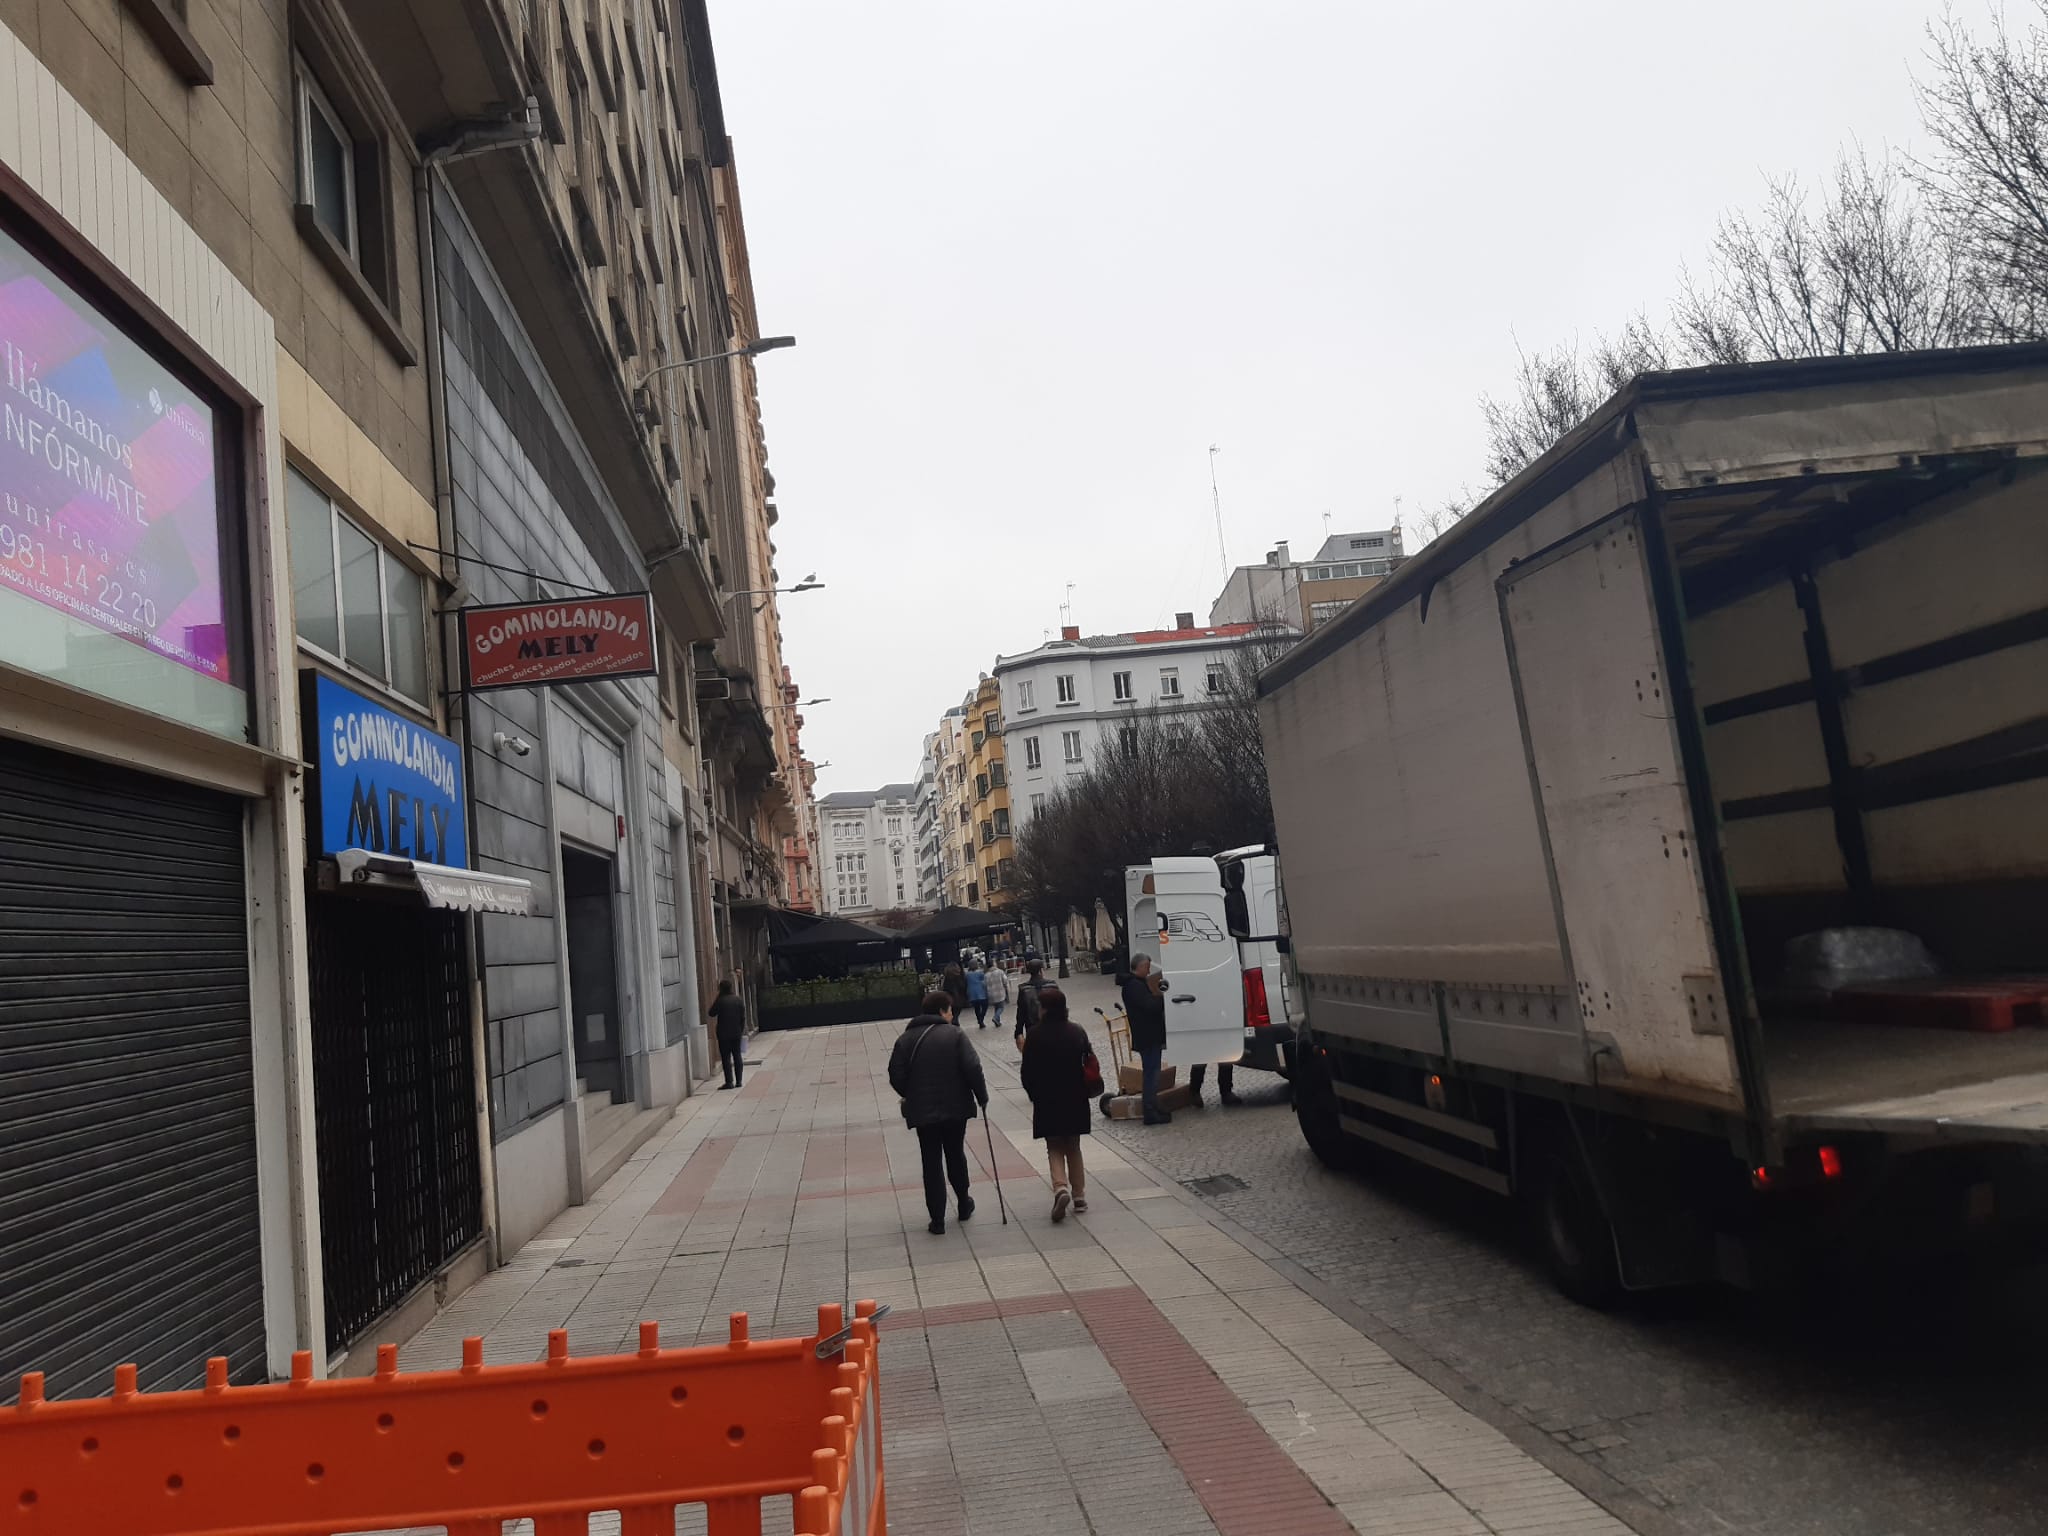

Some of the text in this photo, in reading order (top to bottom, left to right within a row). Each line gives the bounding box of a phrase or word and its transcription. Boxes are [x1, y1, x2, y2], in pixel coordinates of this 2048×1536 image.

[5, 339, 133, 470] llámanos
[0, 401, 149, 527] NFÓRMATE
[0, 523, 156, 628] 981 14 22 20
[475, 608, 640, 654] GOMINOLANDIA
[476, 650, 645, 684] chuches dulces salados bebidas helados
[517, 633, 599, 660] MELY
[333, 712, 456, 803] GOMINOLANDIA
[346, 772, 449, 866] MELY
